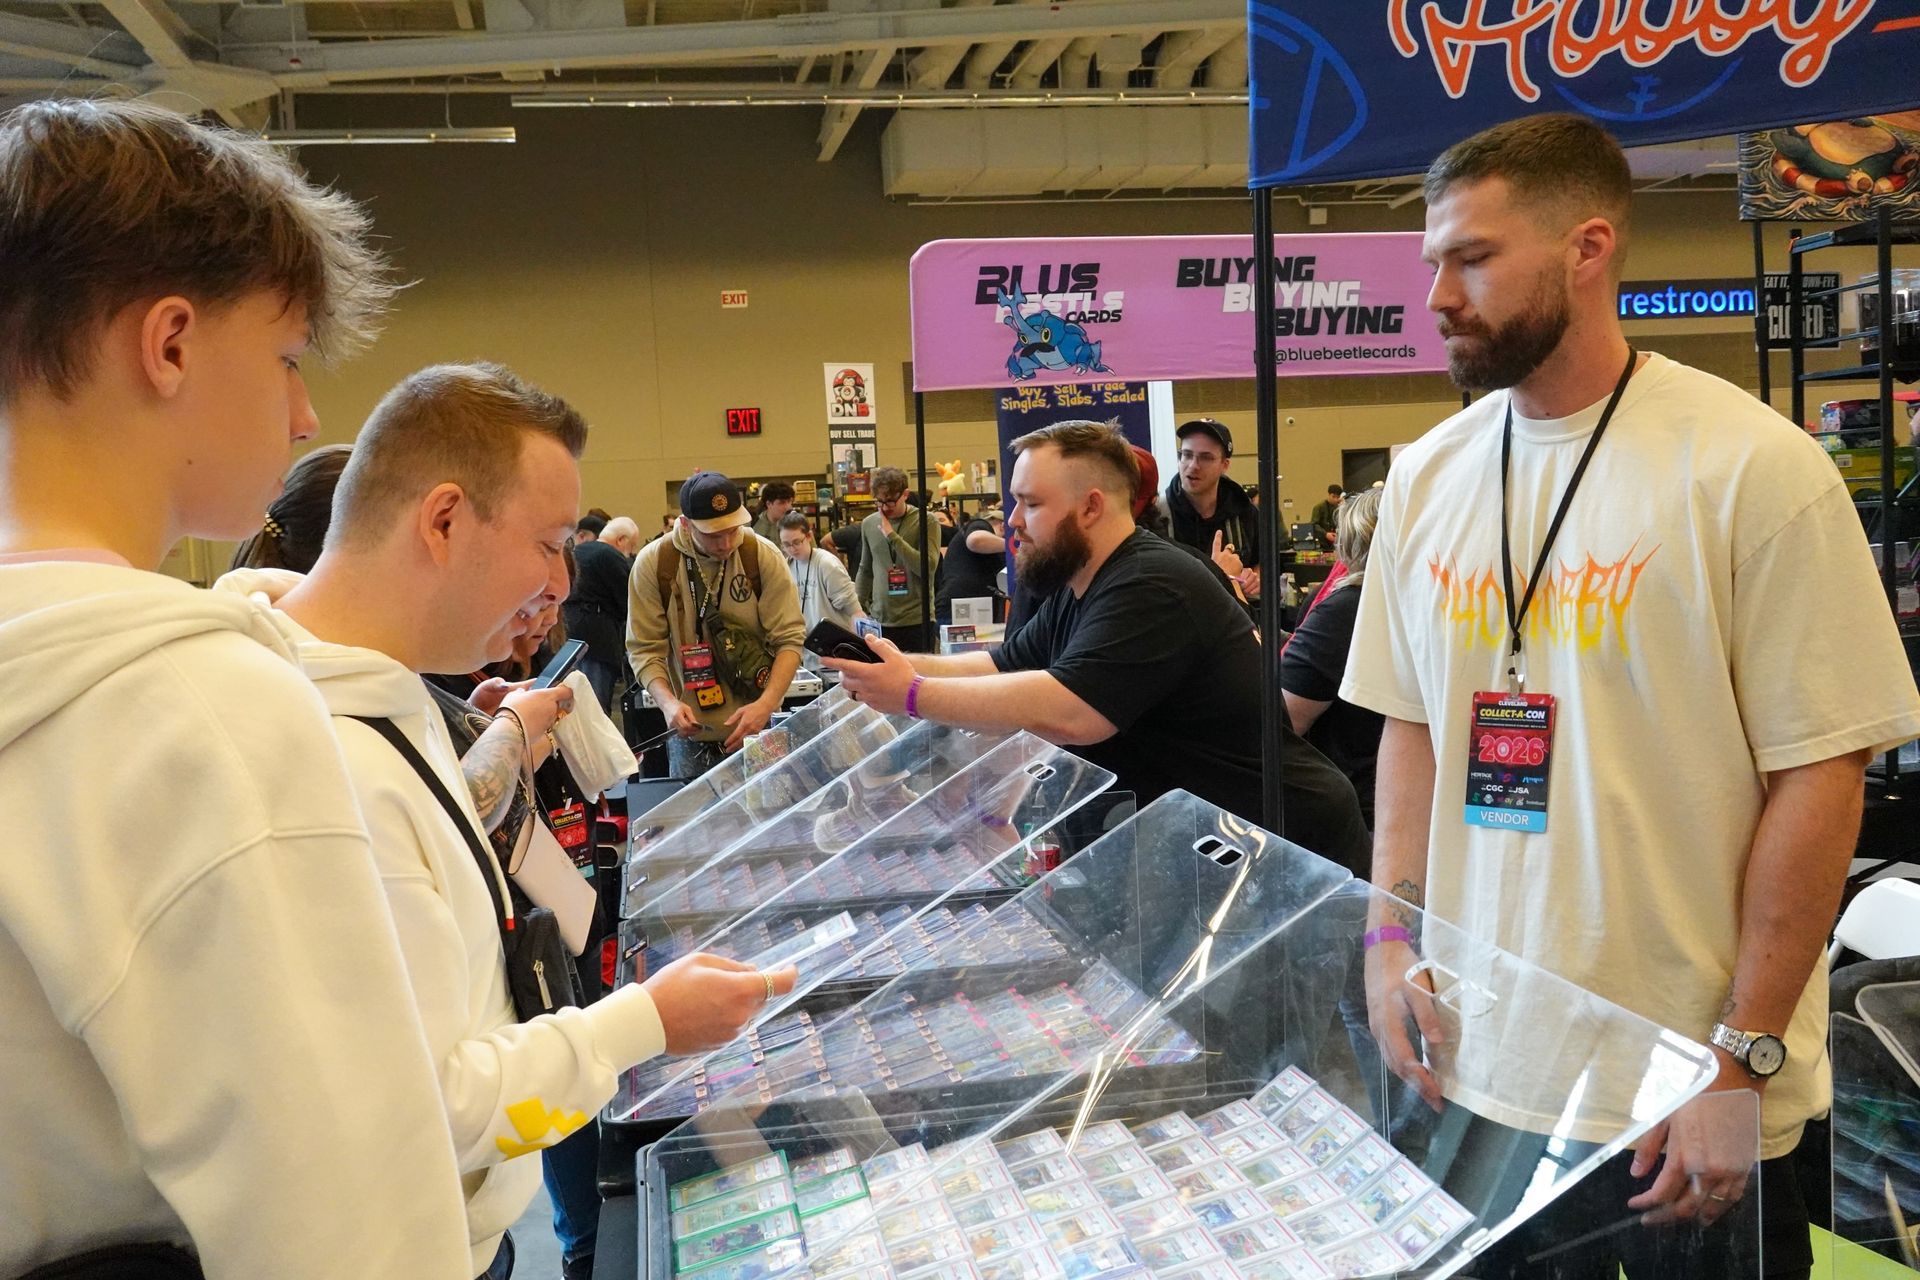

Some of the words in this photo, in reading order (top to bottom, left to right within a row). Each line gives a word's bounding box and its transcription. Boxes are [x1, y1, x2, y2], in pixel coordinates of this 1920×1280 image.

[1176, 256, 1316, 288] BUYNG
[722, 293, 748, 305] EXIT
[1620, 285, 1754, 315] restroom
[1066, 309, 1123, 323] CARDS
[1275, 305, 1405, 336] BUYING
[831, 402, 870, 417] DNB
[1001, 397, 1051, 413] Singles,
[1057, 394, 1097, 407] Slabs,
[1104, 387, 1146, 403] Sealed
[728, 409, 759, 433] EXIT
[830, 430, 842, 438] BUY
[843, 430, 857, 438] SELL
[857, 430, 875, 438] TRADE
[1478, 734, 1545, 766] 2026
[1486, 784, 1504, 792] CGC
[1480, 811, 1529, 825] VENDOR
